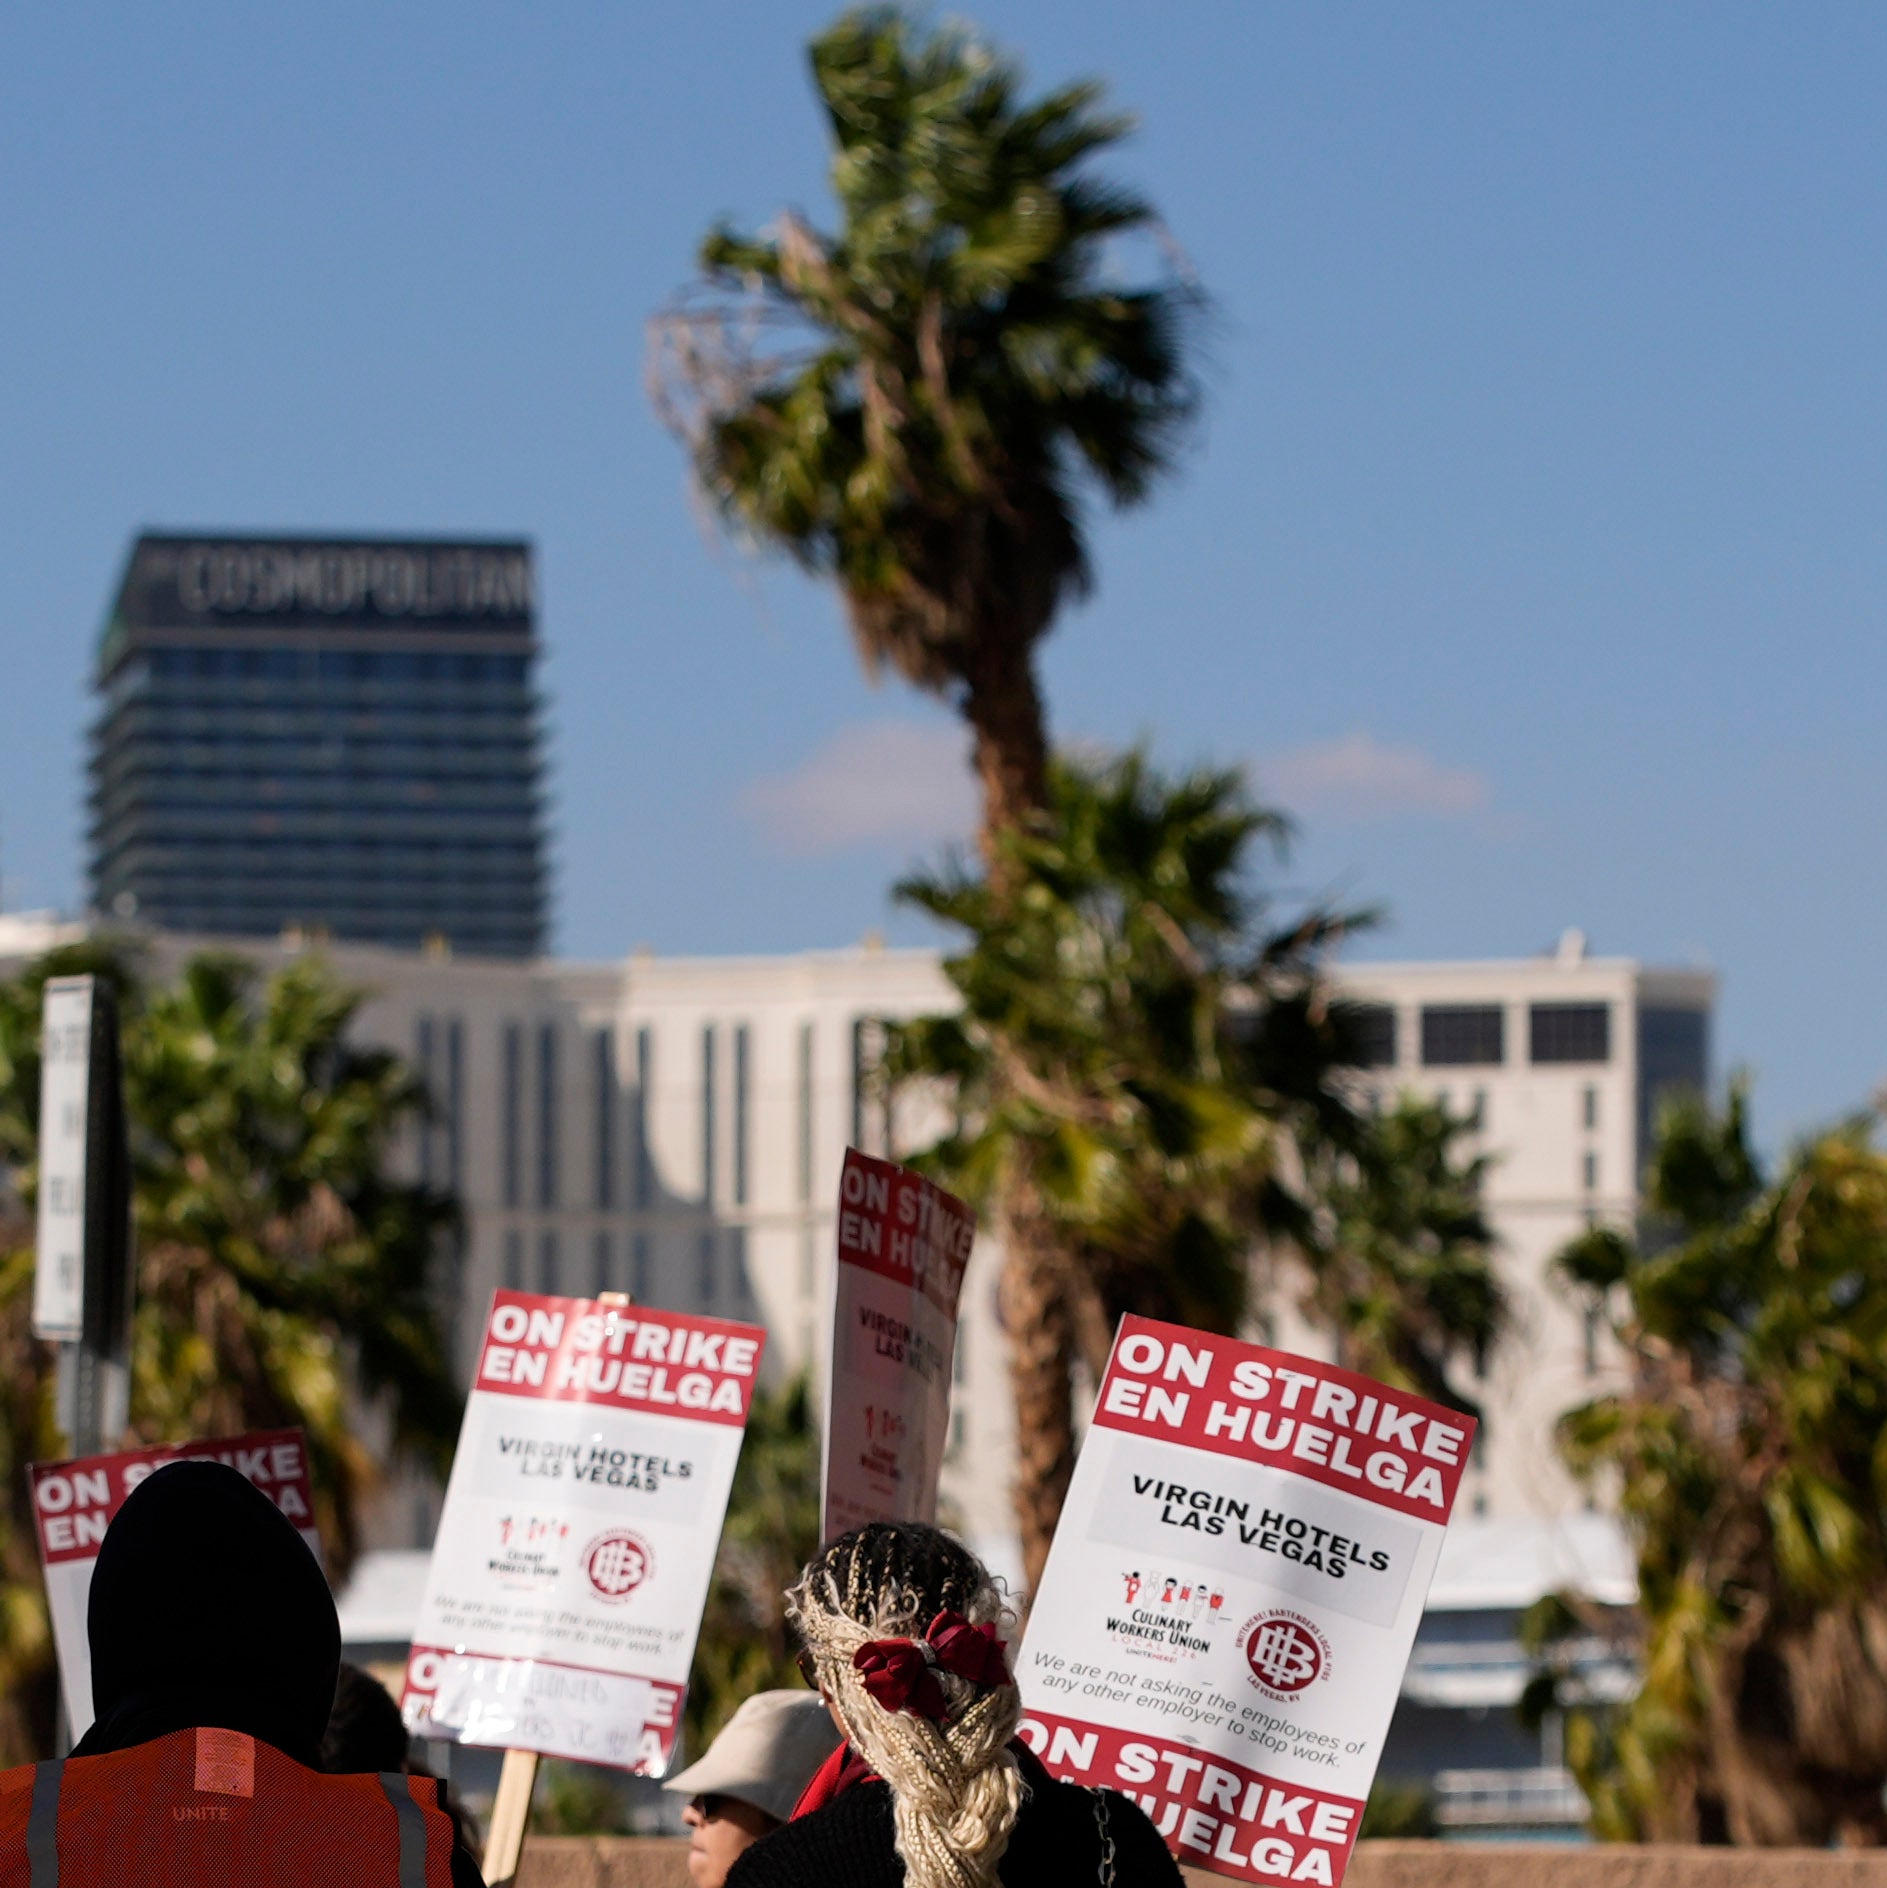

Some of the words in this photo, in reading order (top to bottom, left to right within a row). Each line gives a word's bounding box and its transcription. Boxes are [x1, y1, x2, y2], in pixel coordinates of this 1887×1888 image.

[844, 1165, 889, 1215] ON
[841, 1210, 882, 1255] EN
[491, 1306, 564, 1348] ON
[574, 1314, 758, 1375] STRIKE
[481, 1347, 548, 1387] EN
[558, 1355, 744, 1415] HUELGA
[1117, 1334, 1214, 1389] ON
[1229, 1360, 1465, 1466] STRIKE
[499, 1436, 580, 1461] VIRGIN
[589, 1447, 693, 1478] HOTELS
[520, 1459, 561, 1478] LAS
[574, 1465, 659, 1493] VEGAS
[1104, 1376, 1190, 1428] EN
[1204, 1400, 1445, 1509] HUELGA
[36, 1469, 111, 1513] ON
[1133, 1474, 1249, 1522] VIRGIN
[1261, 1509, 1390, 1572] HOTELS
[43, 1510, 110, 1551] EN
[1161, 1505, 1225, 1536] LAS
[1238, 1523, 1346, 1580] VEGAS
[1106, 1617, 1166, 1643] WORKERS
[1169, 1631, 1211, 1654] UNION
[1113, 1634, 1163, 1652] LOCAL
[1131, 1608, 1193, 1634] CULINARY
[1035, 1651, 1065, 1672] We
[1070, 1663, 1102, 1679] are
[1106, 1669, 1137, 1687] not
[1141, 1676, 1203, 1706] asking
[1207, 1692, 1237, 1713] the
[1242, 1706, 1340, 1751] employees
[1346, 1740, 1367, 1757] of
[1043, 1673, 1078, 1695] any
[1082, 1682, 1132, 1704] other
[1136, 1695, 1223, 1729] employer
[1228, 1717, 1246, 1735] to
[1249, 1726, 1288, 1753] stop
[1293, 1746, 1340, 1768] work.
[1014, 1718, 1100, 1771] ON
[1115, 1743, 1355, 1844] STRIKE
[1130, 1785, 1333, 1887] UELGA
